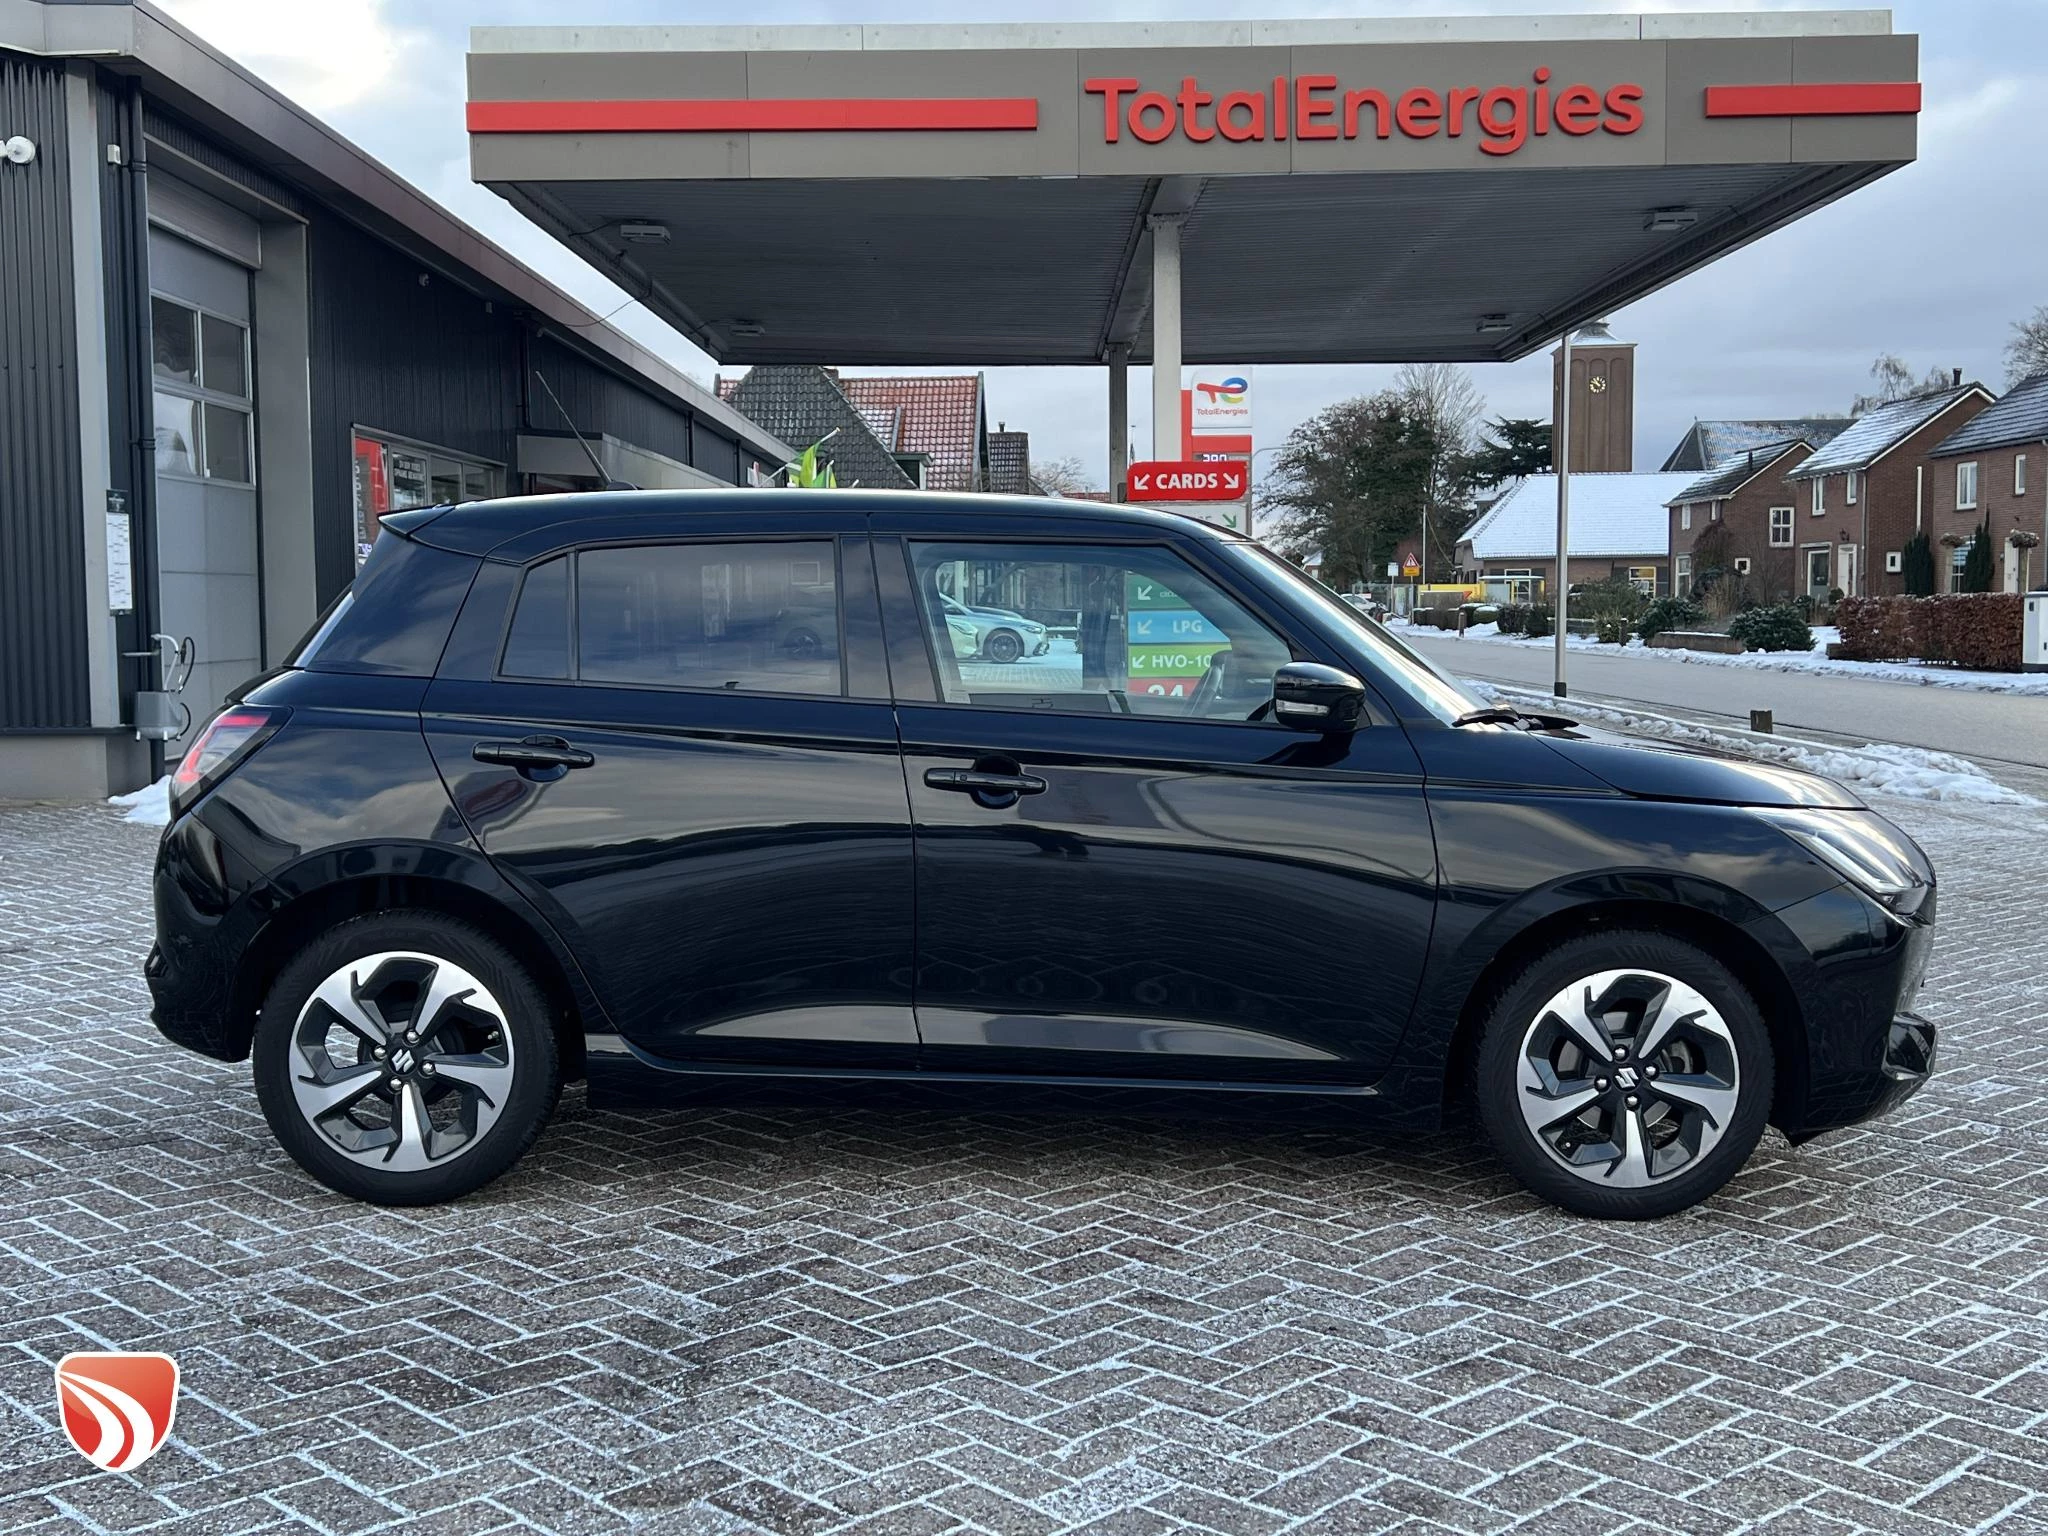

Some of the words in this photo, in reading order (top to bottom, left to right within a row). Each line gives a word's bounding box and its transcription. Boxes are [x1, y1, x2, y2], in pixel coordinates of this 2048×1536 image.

[1085, 67, 1645, 155] TotalEnergies
[1196, 408, 1248, 416] TotalEnergies
[1155, 473, 1218, 489] CARDS
[1172, 620, 1203, 633] LPG
